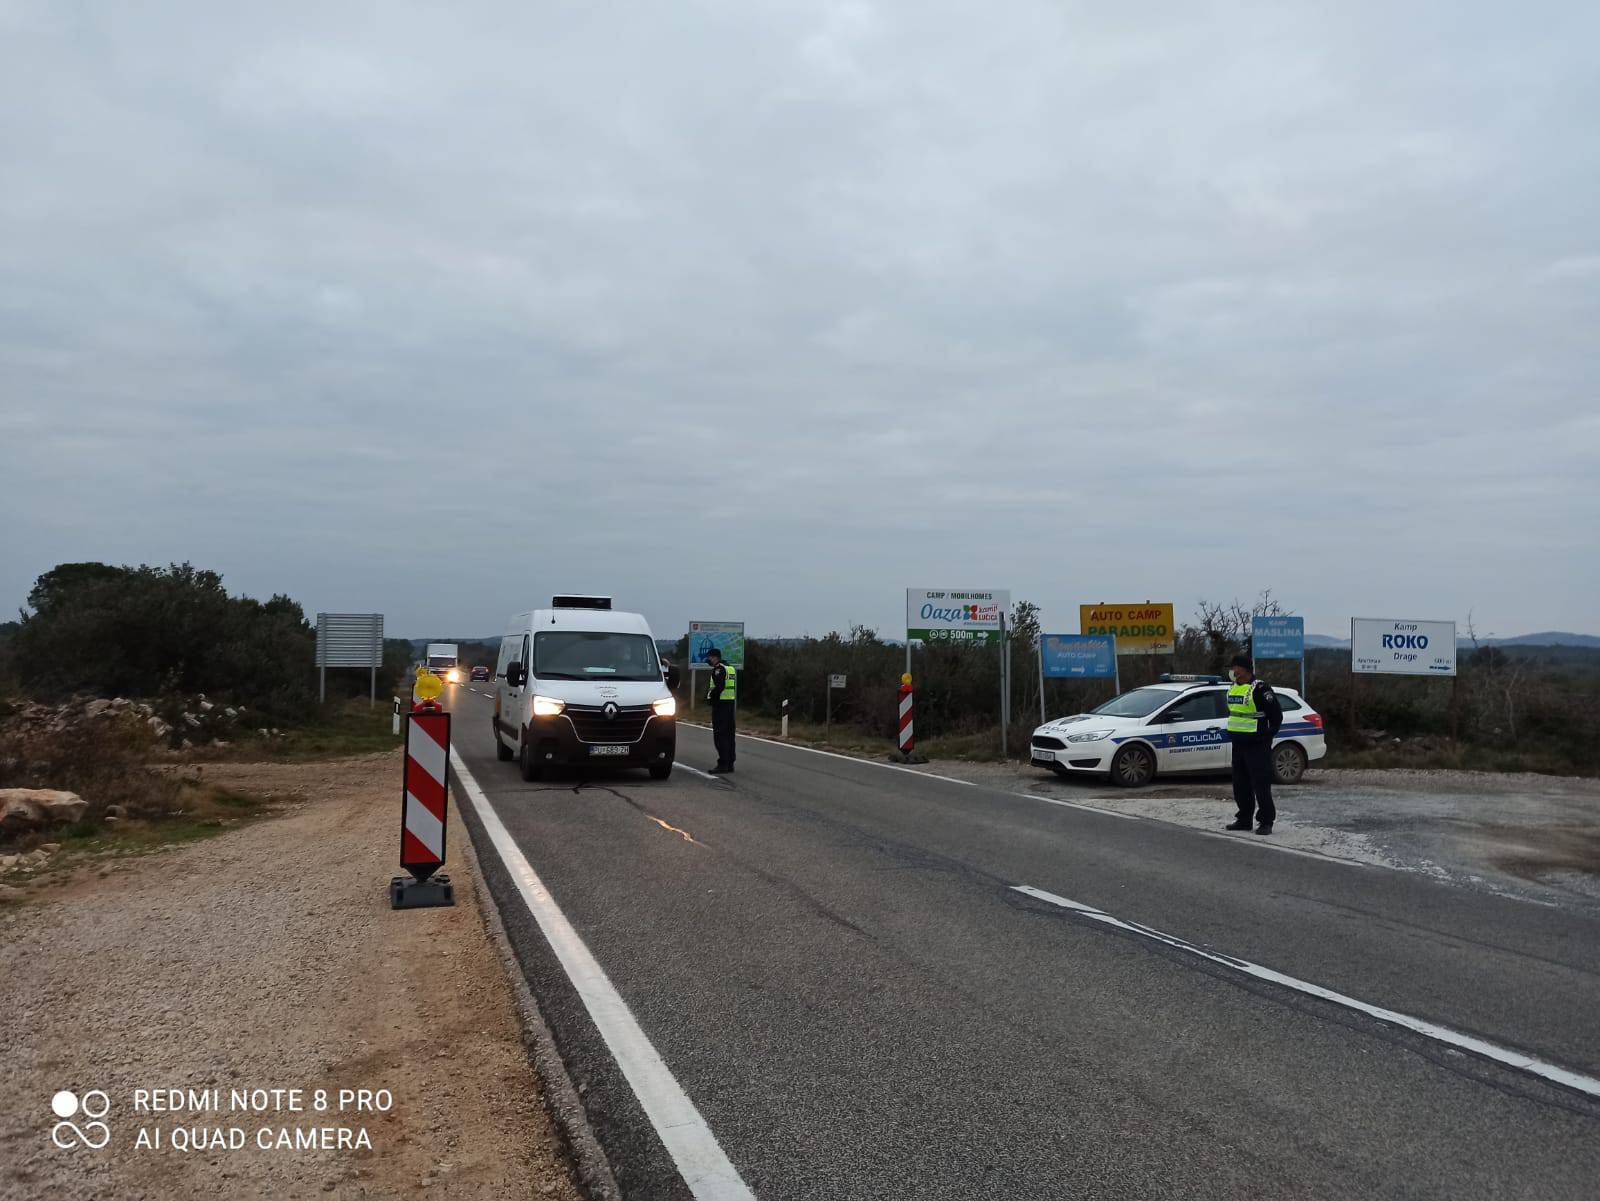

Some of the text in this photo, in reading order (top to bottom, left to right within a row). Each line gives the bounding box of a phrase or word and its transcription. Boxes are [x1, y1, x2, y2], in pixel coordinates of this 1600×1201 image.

[951, 592, 993, 600] MOBILHOMES
[920, 603, 962, 622] Oaza
[1090, 609, 1162, 621] AUTO CAMP
[1088, 624, 1168, 638] PARADISO
[1394, 622, 1418, 632] Kamp
[950, 630, 974, 640] 500m
[1254, 628, 1302, 638] MASLINA
[1382, 634, 1429, 650] ROKO
[1393, 652, 1418, 662] Drage
[1182, 733, 1223, 743] POLICIJA
